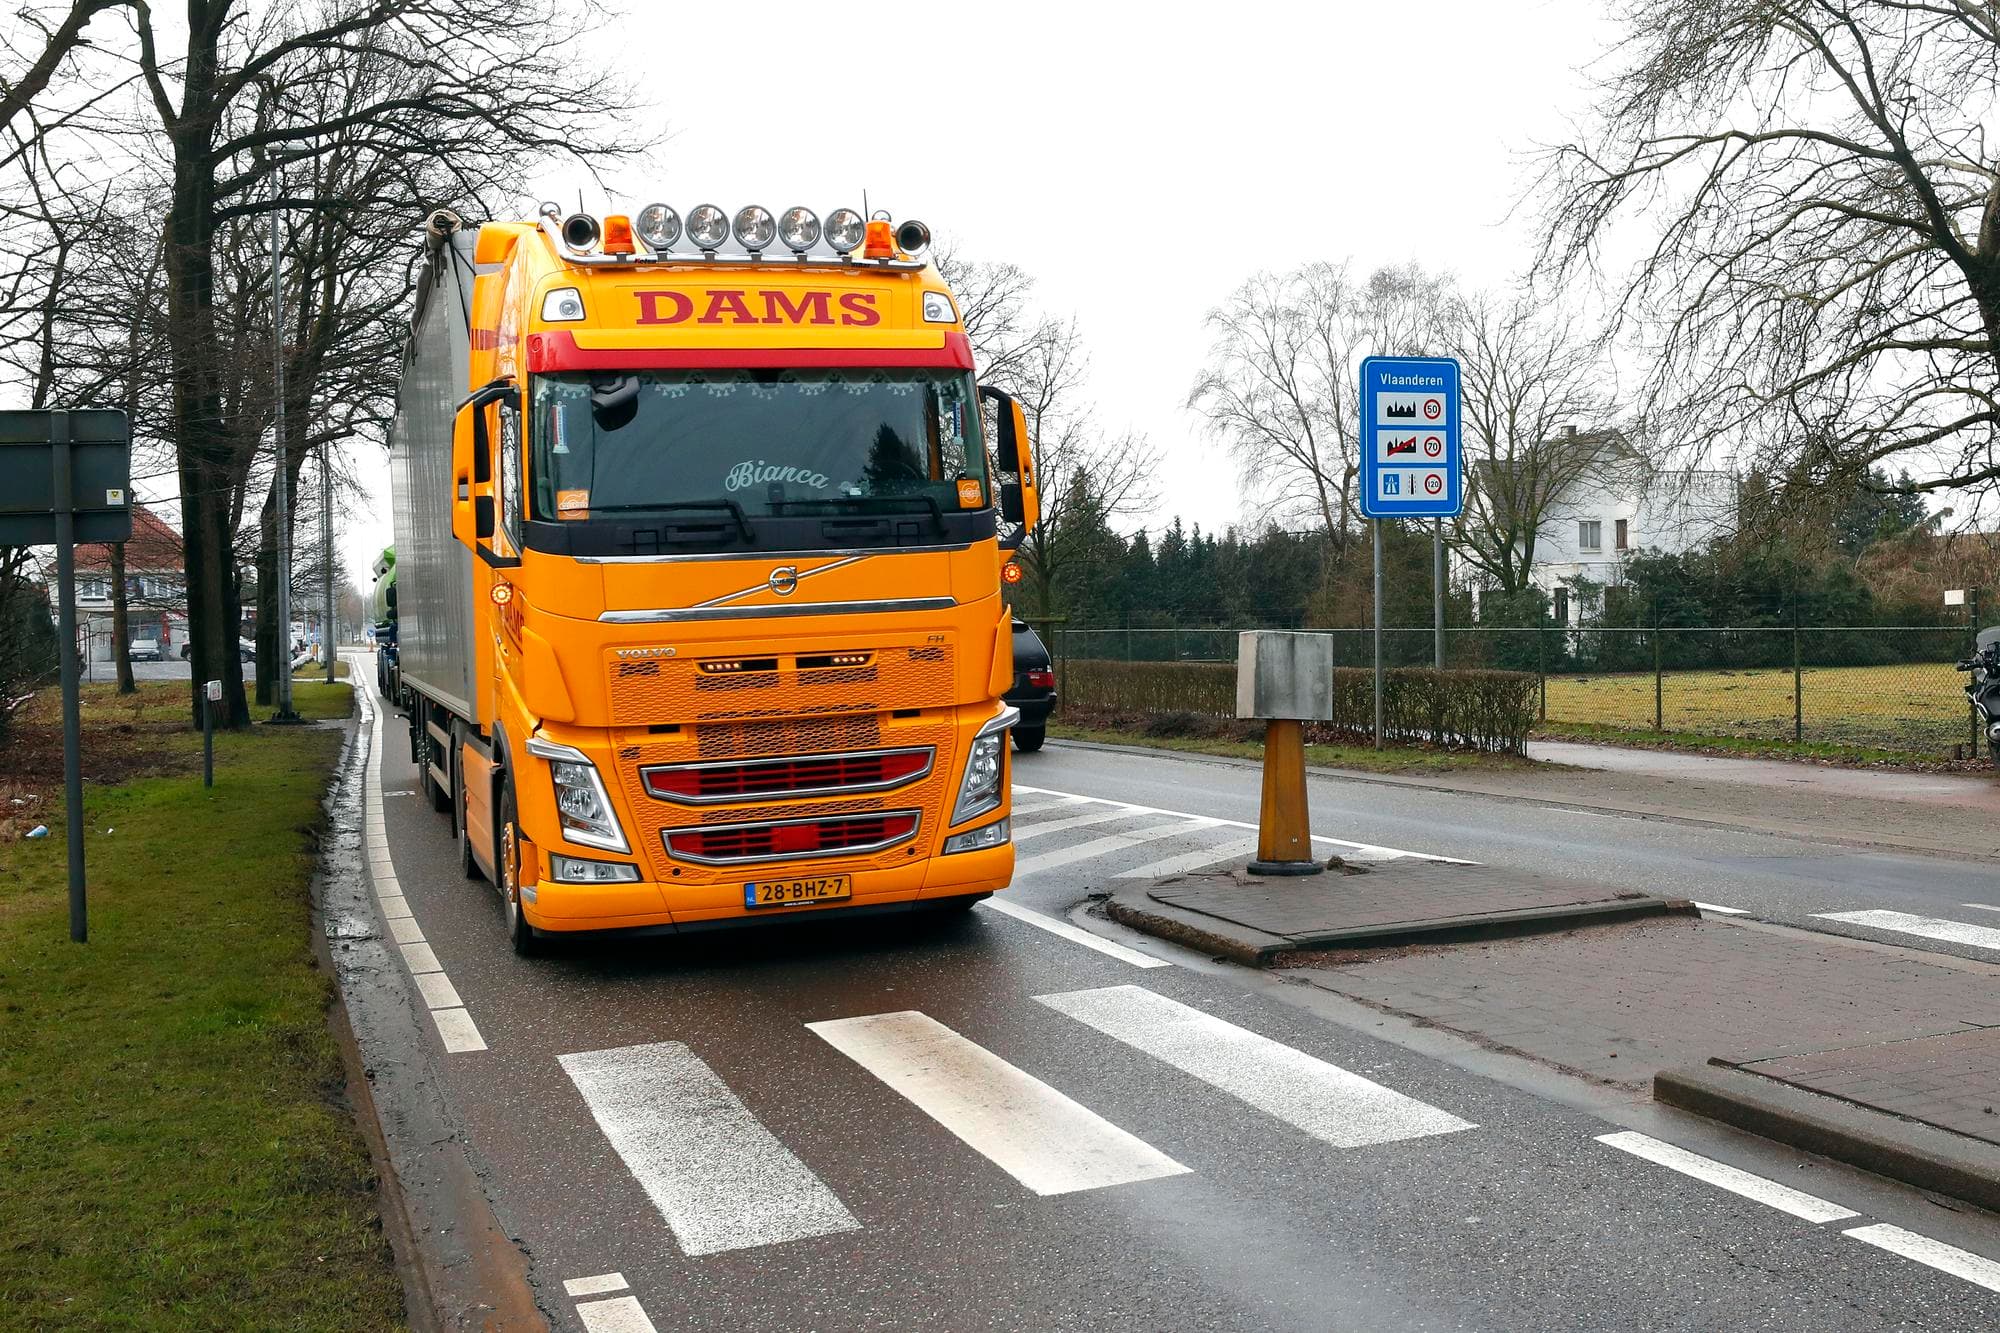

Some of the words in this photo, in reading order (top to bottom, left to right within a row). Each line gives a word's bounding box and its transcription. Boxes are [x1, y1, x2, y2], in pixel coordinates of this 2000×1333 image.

[633, 290, 881, 327] DAMS
[1380, 373, 1443, 386] Vlaanderen
[1427, 405, 1438, 414] 50
[1427, 442, 1438, 451] 70
[725, 460, 830, 492] Bianca
[1427, 480, 1439, 488] 120
[928, 634, 945, 643] FH
[616, 647, 676, 659] VOLVO
[762, 879, 843, 901] 28-BHZ-7
